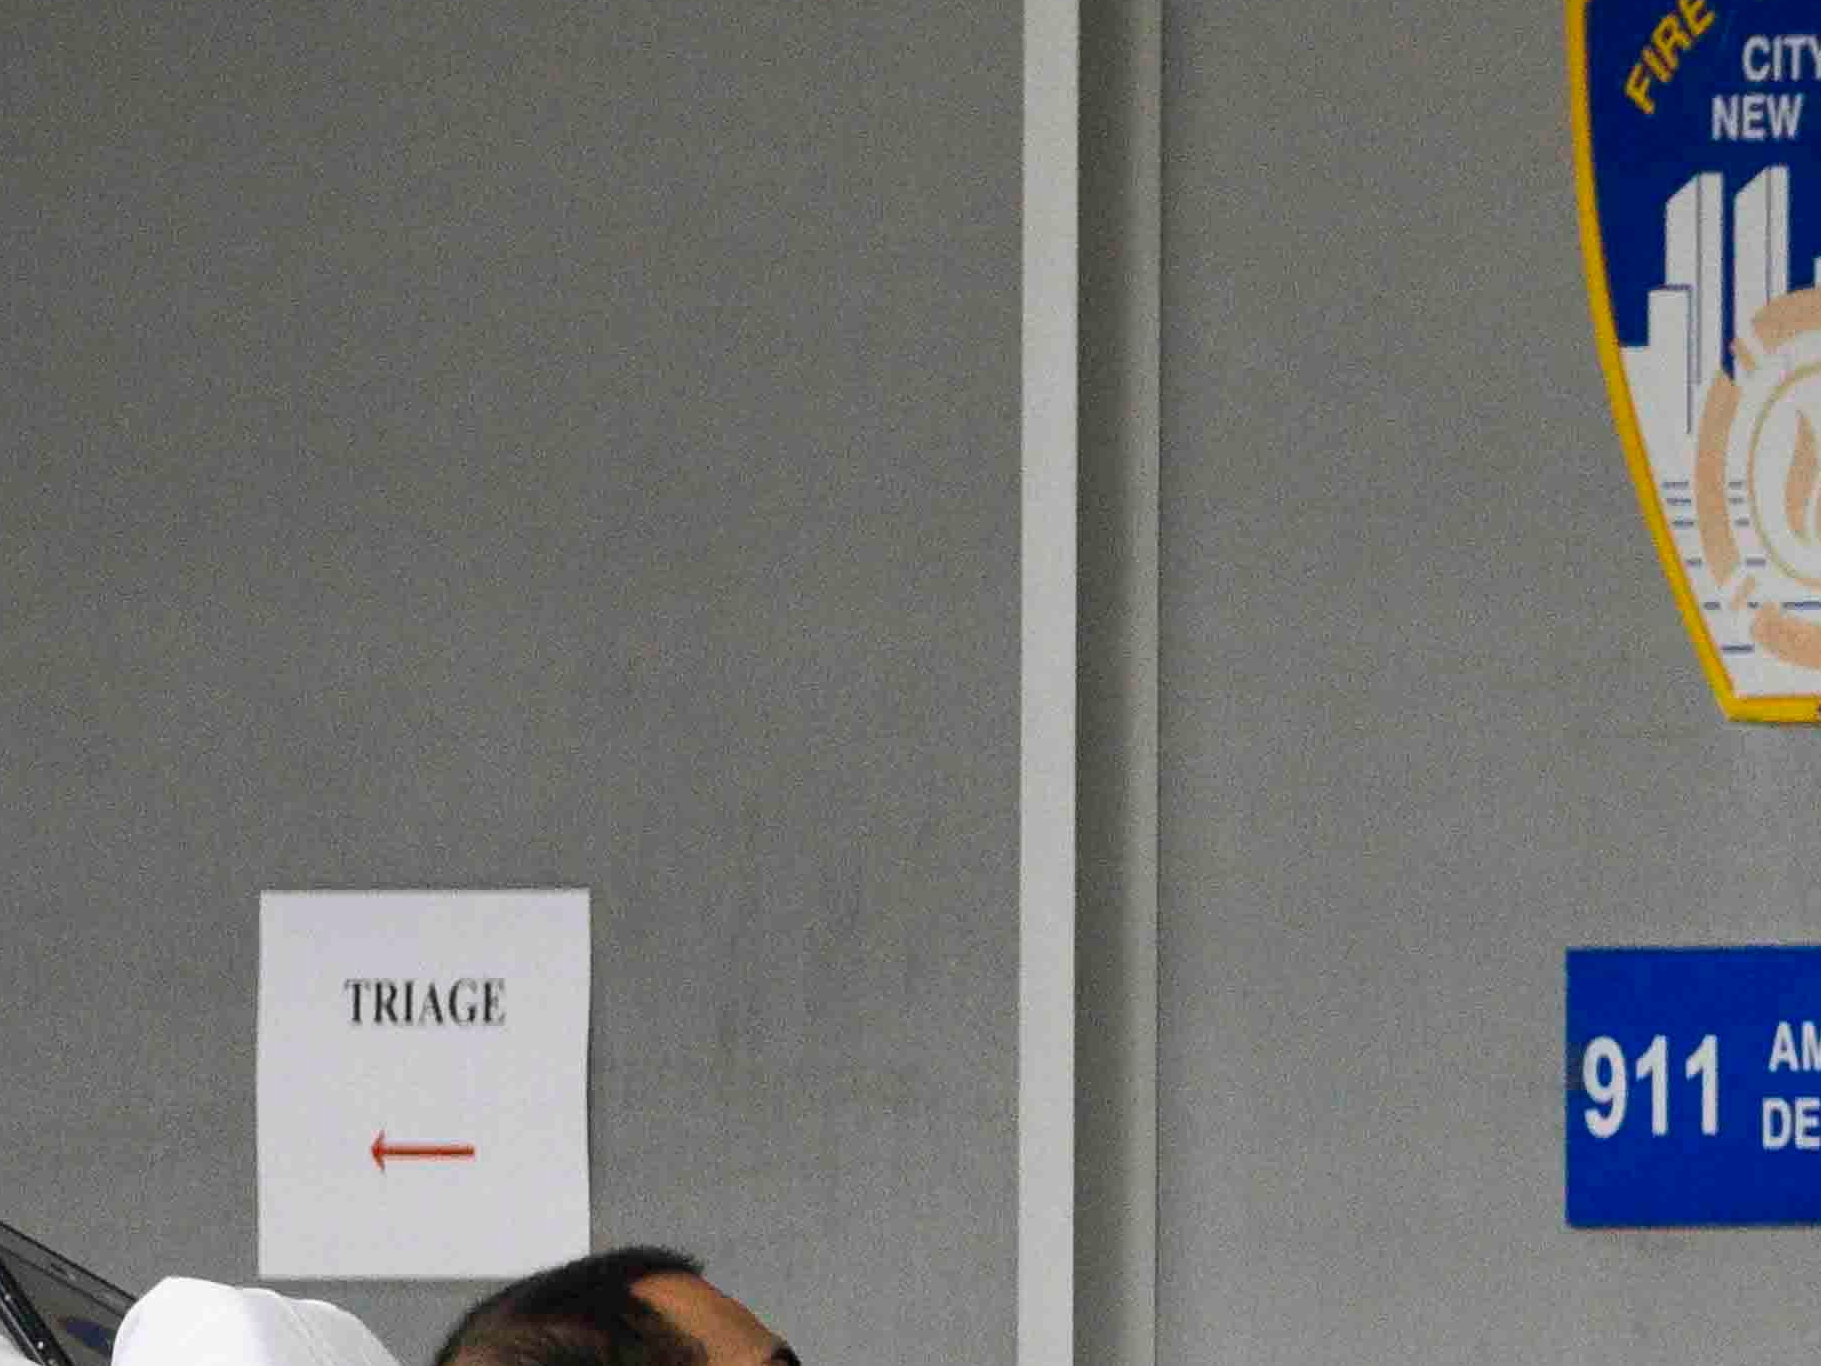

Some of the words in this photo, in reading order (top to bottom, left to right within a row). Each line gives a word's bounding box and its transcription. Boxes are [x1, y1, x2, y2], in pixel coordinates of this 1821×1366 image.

[1625, 0, 1716, 115] FIRE
[1711, 94, 1803, 141] NEW
[343, 977, 507, 1026] TRIAGE
[1581, 1034, 1720, 1138] 911
